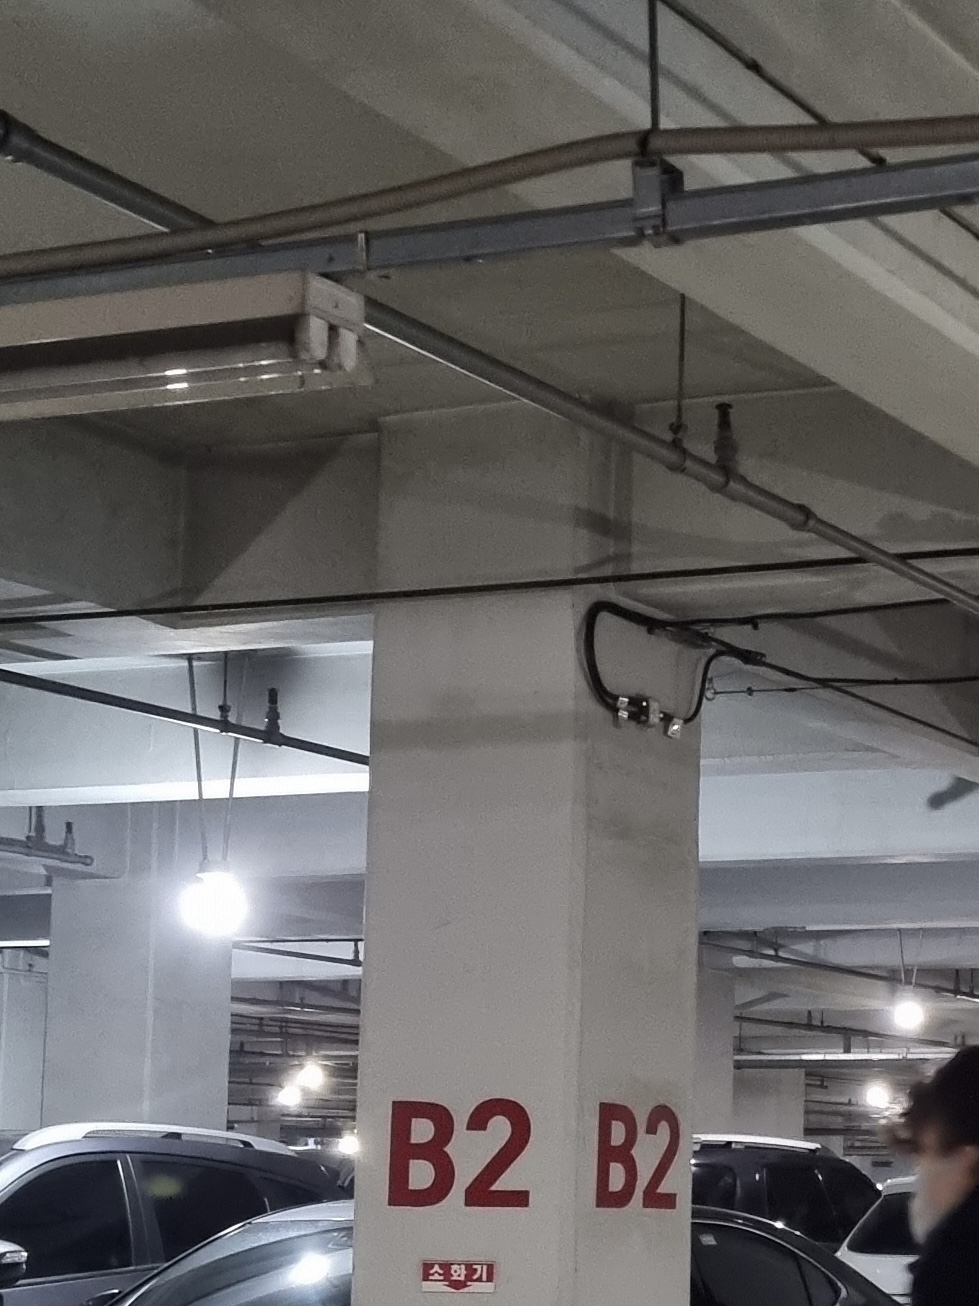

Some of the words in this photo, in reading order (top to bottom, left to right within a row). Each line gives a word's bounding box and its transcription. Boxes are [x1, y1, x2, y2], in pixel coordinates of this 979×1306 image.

[388, 1098, 532, 1208] B2
[595, 1102, 681, 1210] B2
[428, 1263, 488, 1281] 소화기
